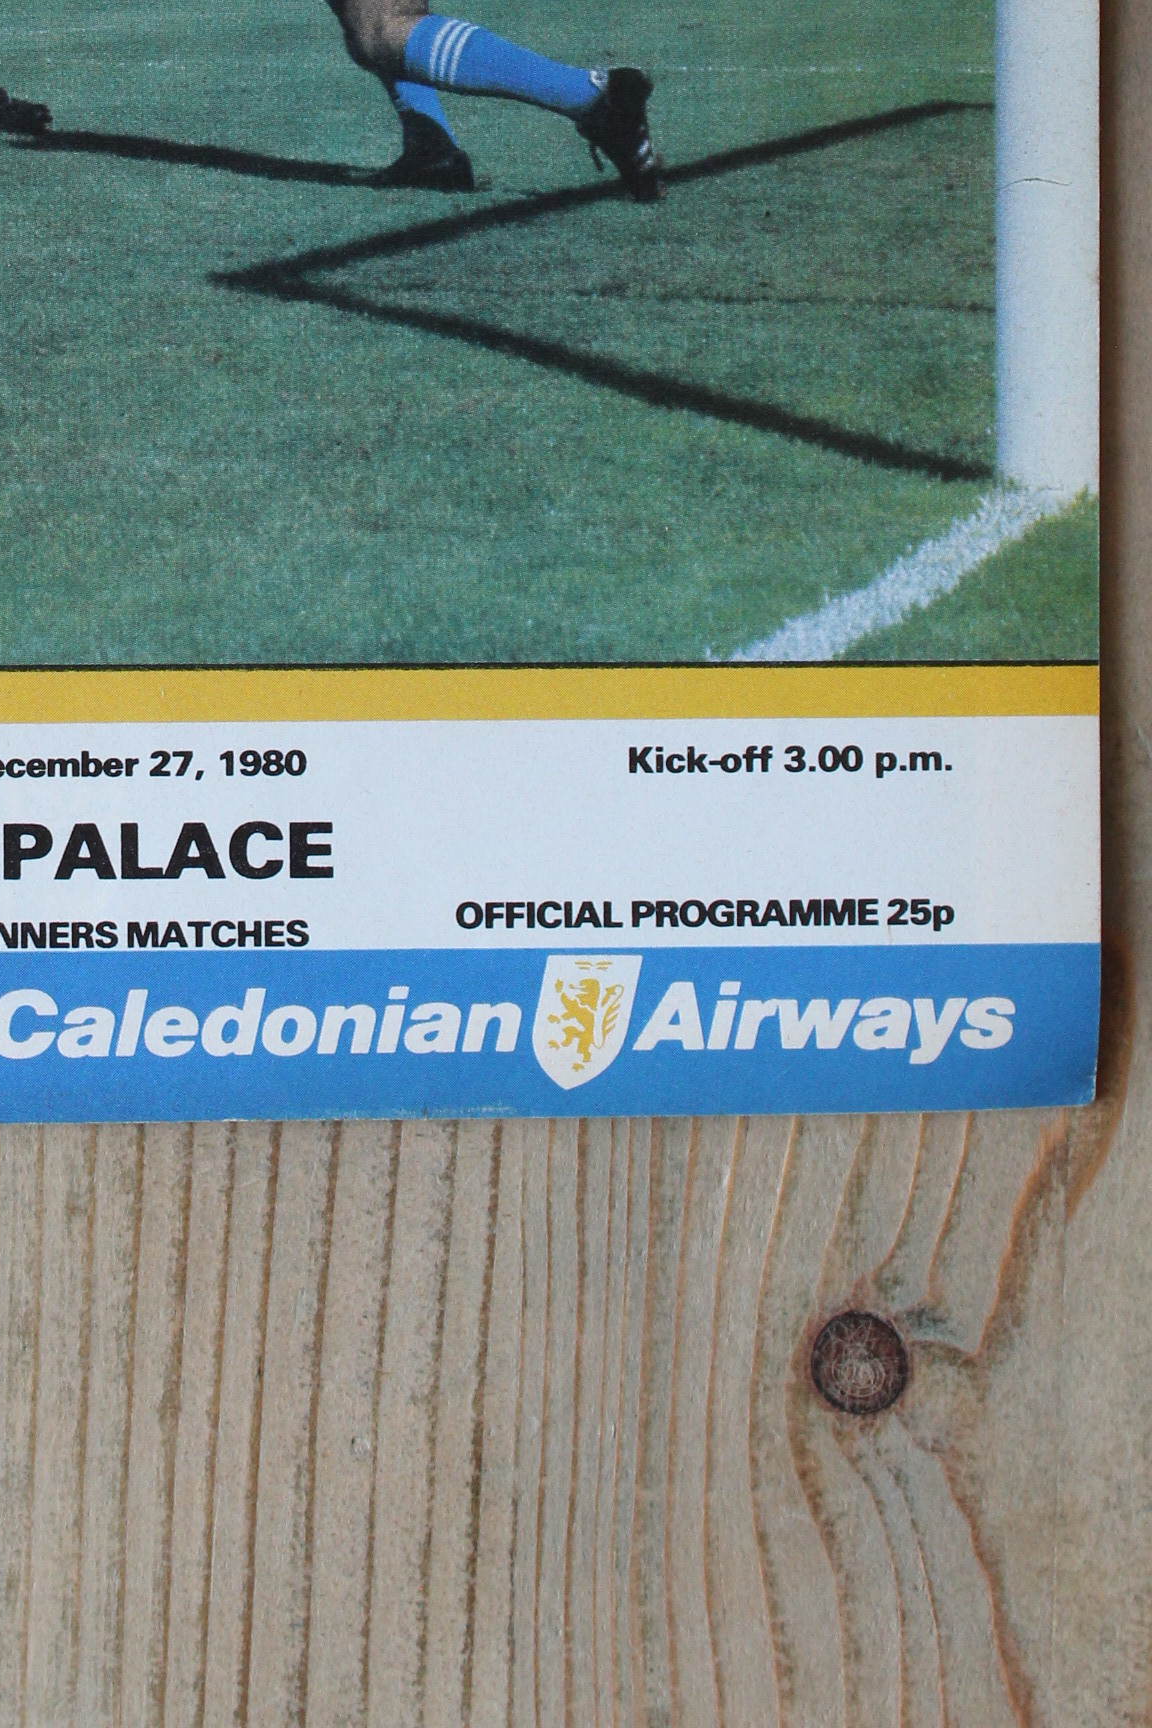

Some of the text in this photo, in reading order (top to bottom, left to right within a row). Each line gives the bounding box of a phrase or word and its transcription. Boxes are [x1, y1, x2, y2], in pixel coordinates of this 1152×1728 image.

[149, 749, 205, 782] 27,
[219, 748, 308, 778] 1980
[628, 744, 953, 779] Kick-off 3.00 p.m.
[3, 821, 335, 881] PALACE
[455, 897, 955, 932] OFFICIAL PROGRAMME 25p
[127, 919, 310, 948] MATCHES
[631, 983, 1016, 1065] Airways
